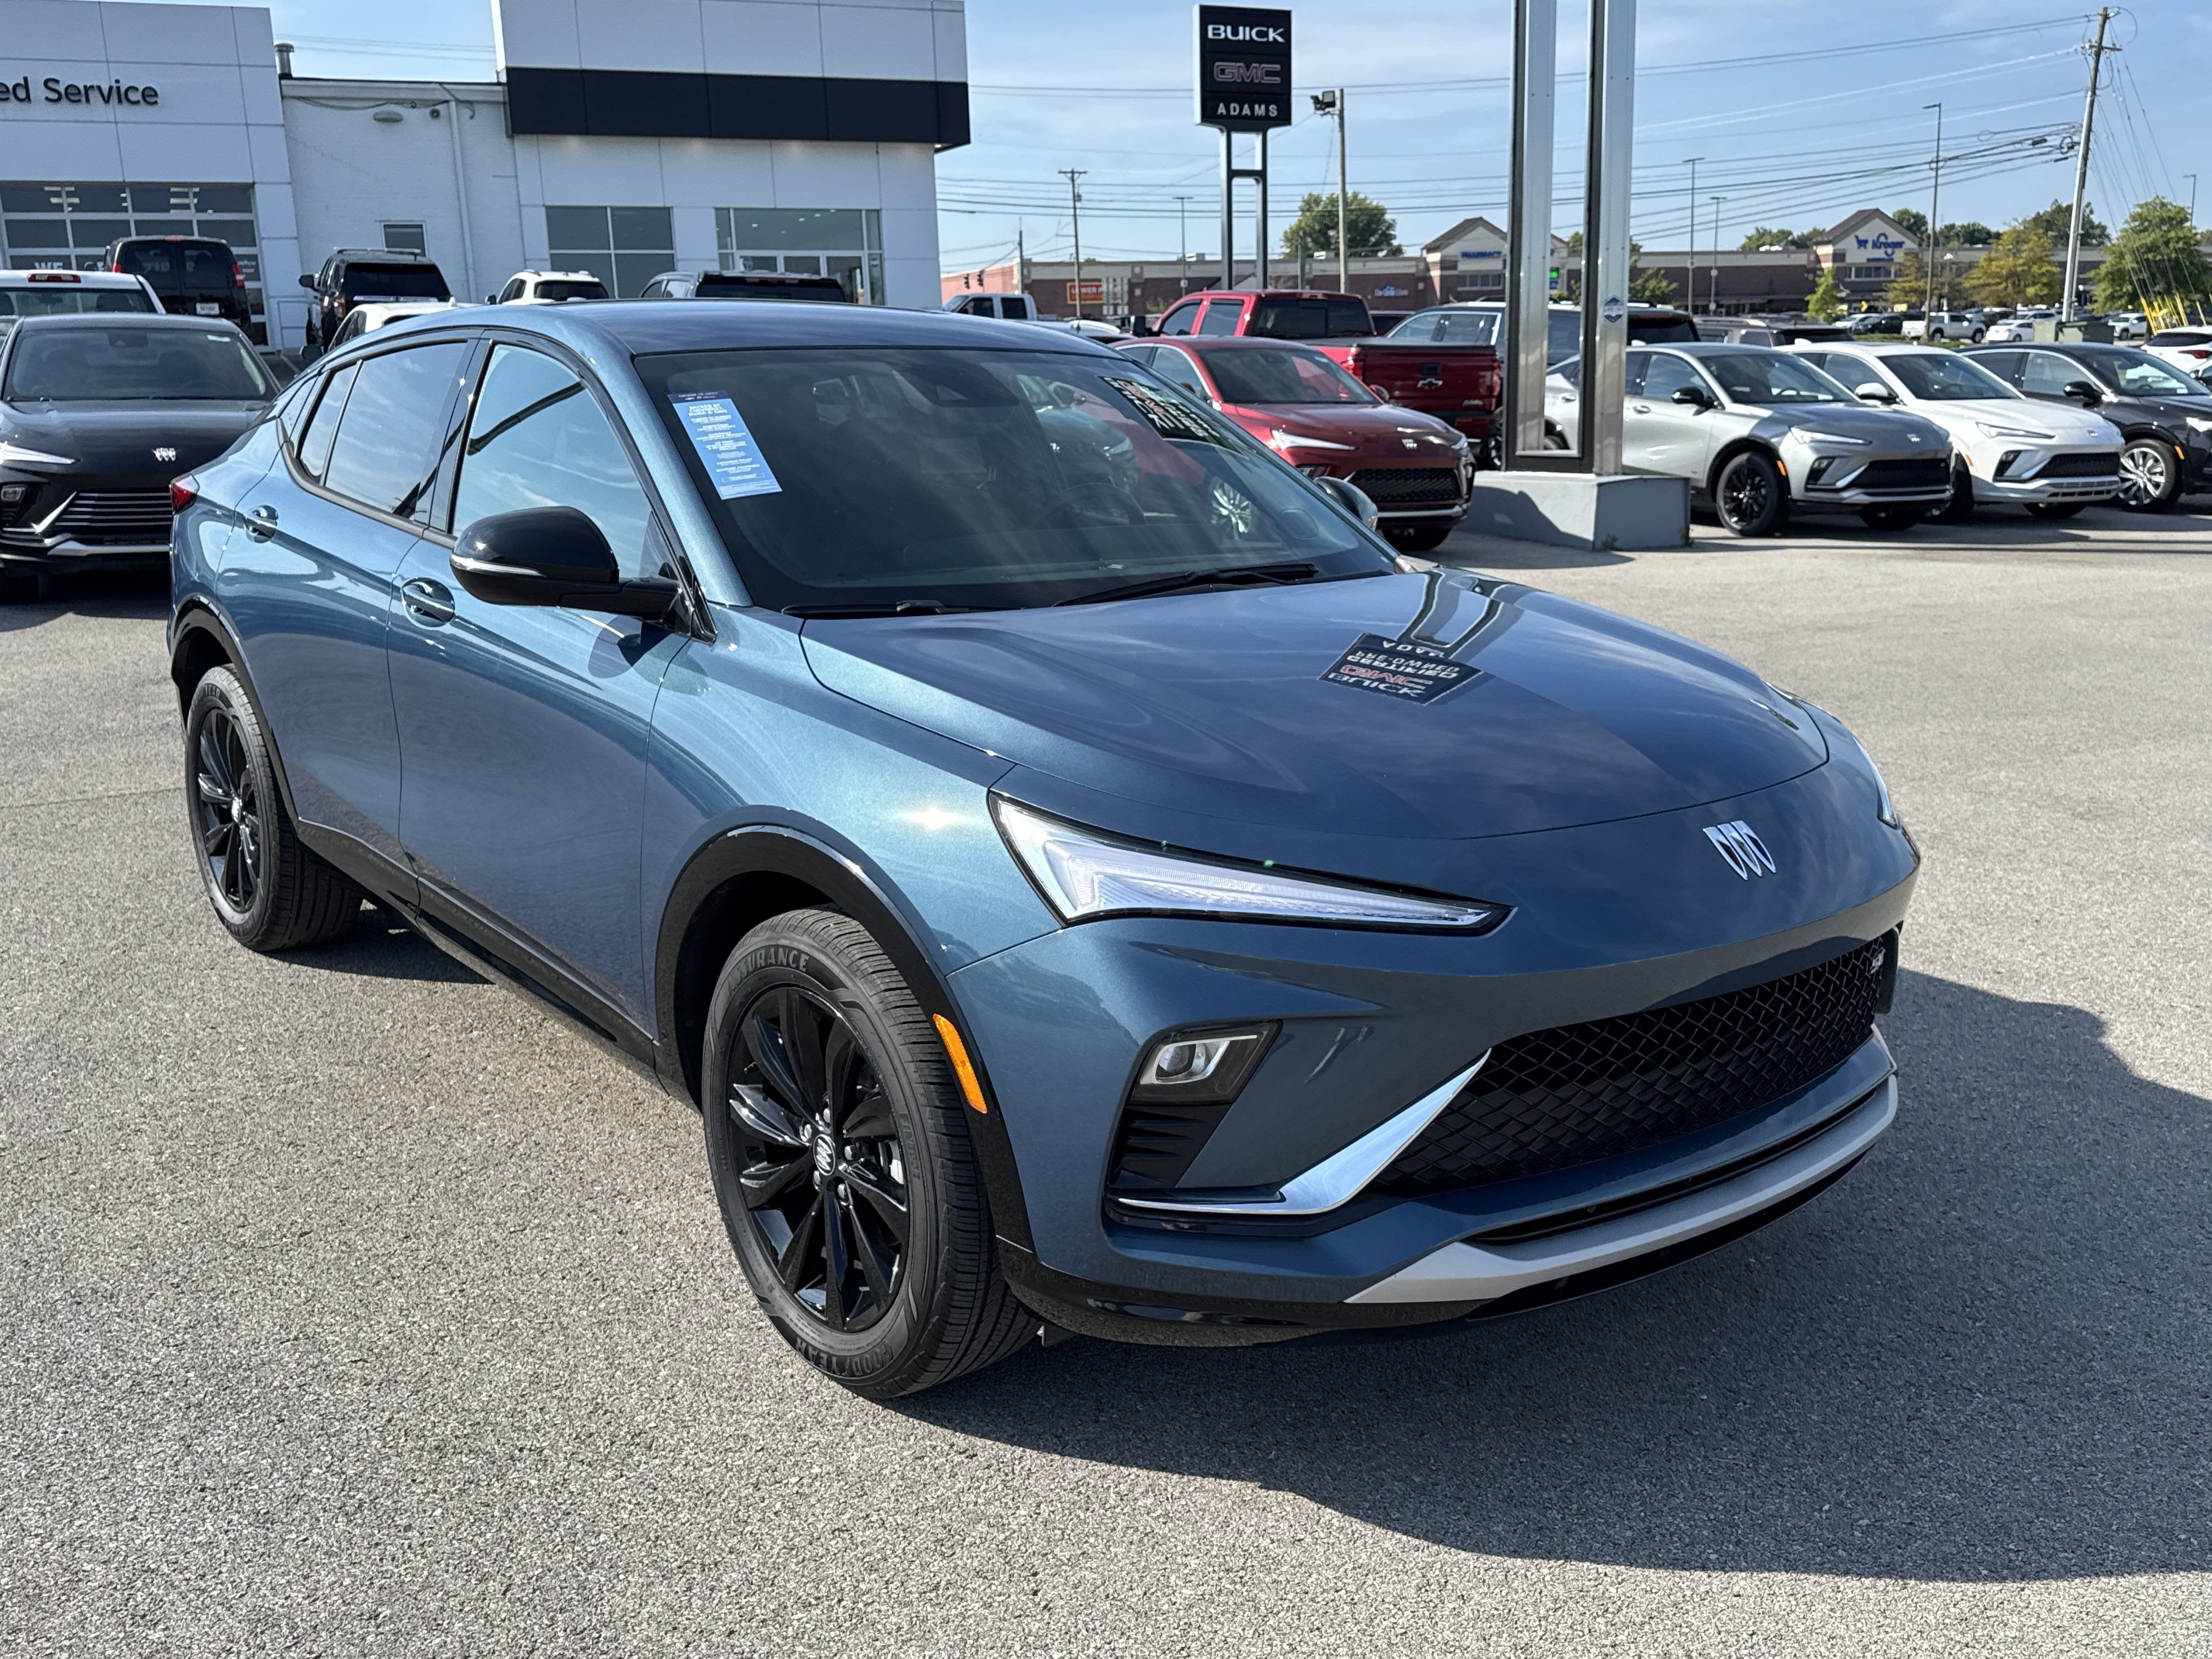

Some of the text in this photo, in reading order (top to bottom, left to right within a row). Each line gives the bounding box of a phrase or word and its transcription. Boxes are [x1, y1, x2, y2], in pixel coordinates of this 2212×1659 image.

[1207, 24, 1285, 43] BUICK
[1214, 61, 1281, 84] GMC
[43, 77, 159, 105] Service
[1217, 103, 1278, 117] ADAMS
[1871, 233, 1905, 257] Kroger
[727, 947, 810, 997] ASSURANCE
